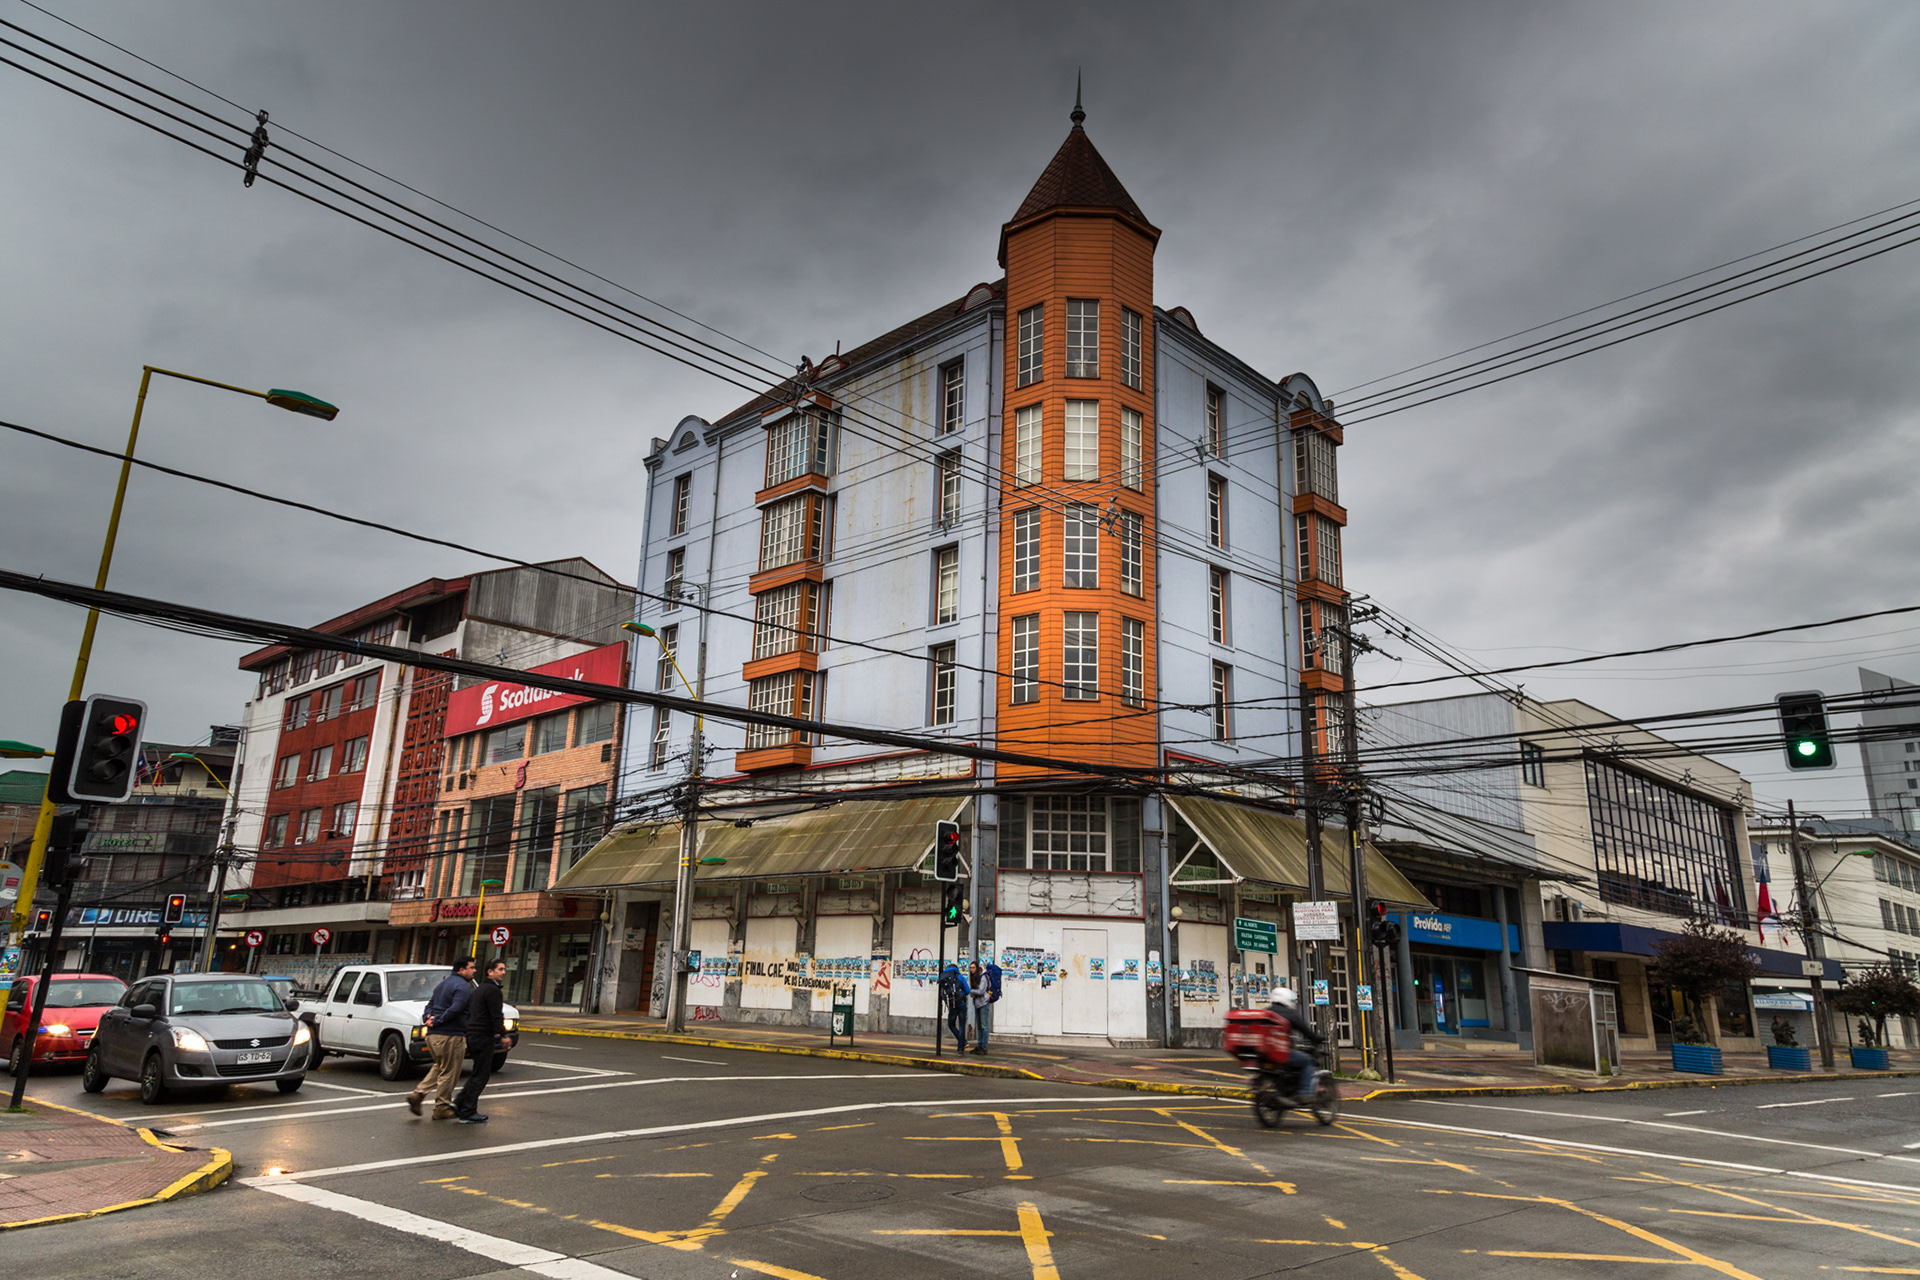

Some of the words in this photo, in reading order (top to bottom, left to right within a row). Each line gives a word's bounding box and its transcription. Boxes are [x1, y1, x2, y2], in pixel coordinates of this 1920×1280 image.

[499, 668, 584, 711] Scotiak
[101, 839, 135, 848] HOTEL
[440, 902, 484, 918] Scotiaban
[1413, 916, 1442, 931] ProVida
[745, 961, 766, 976] FINAL
[767, 962, 784, 978] CAE
